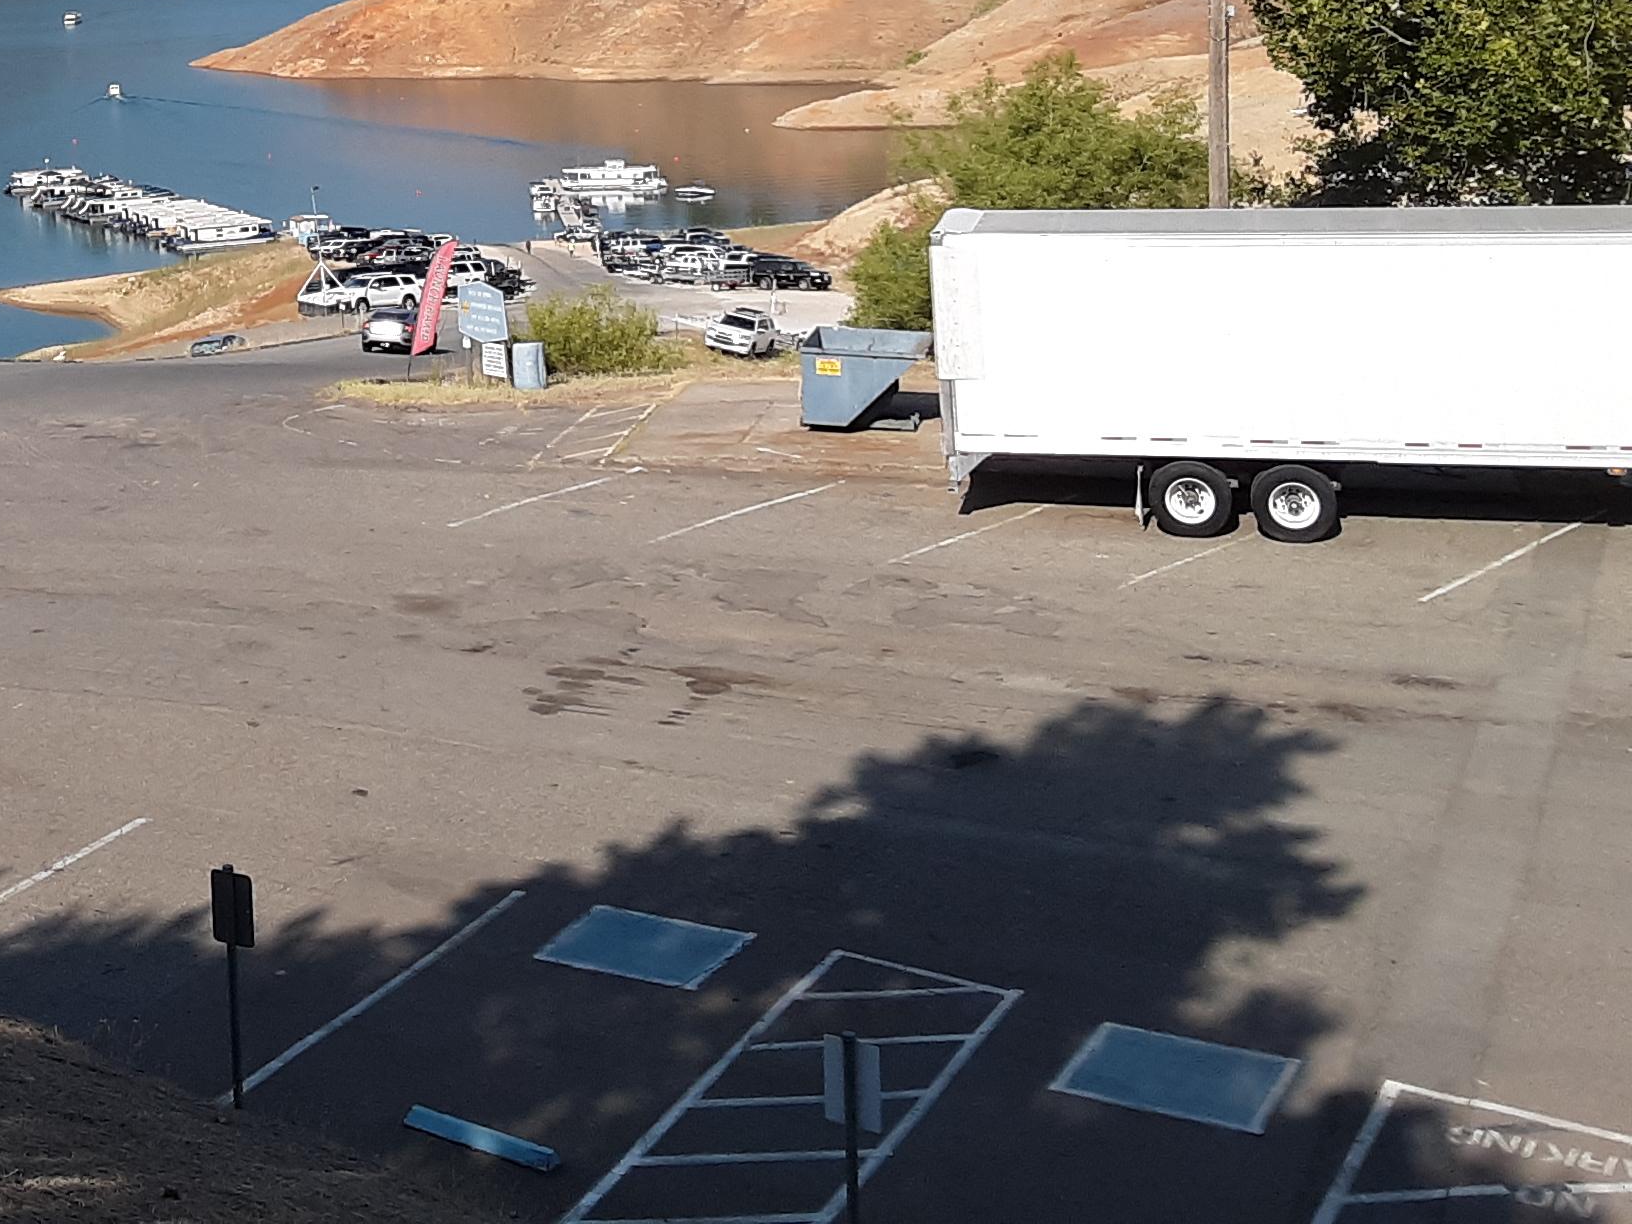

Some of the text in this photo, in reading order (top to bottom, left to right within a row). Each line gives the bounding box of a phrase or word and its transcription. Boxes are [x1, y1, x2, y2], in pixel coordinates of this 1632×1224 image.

[428, 256, 446, 305] LAUNCH
[1446, 1126, 1632, 1178] RKING
[1514, 1186, 1596, 1218] NO
